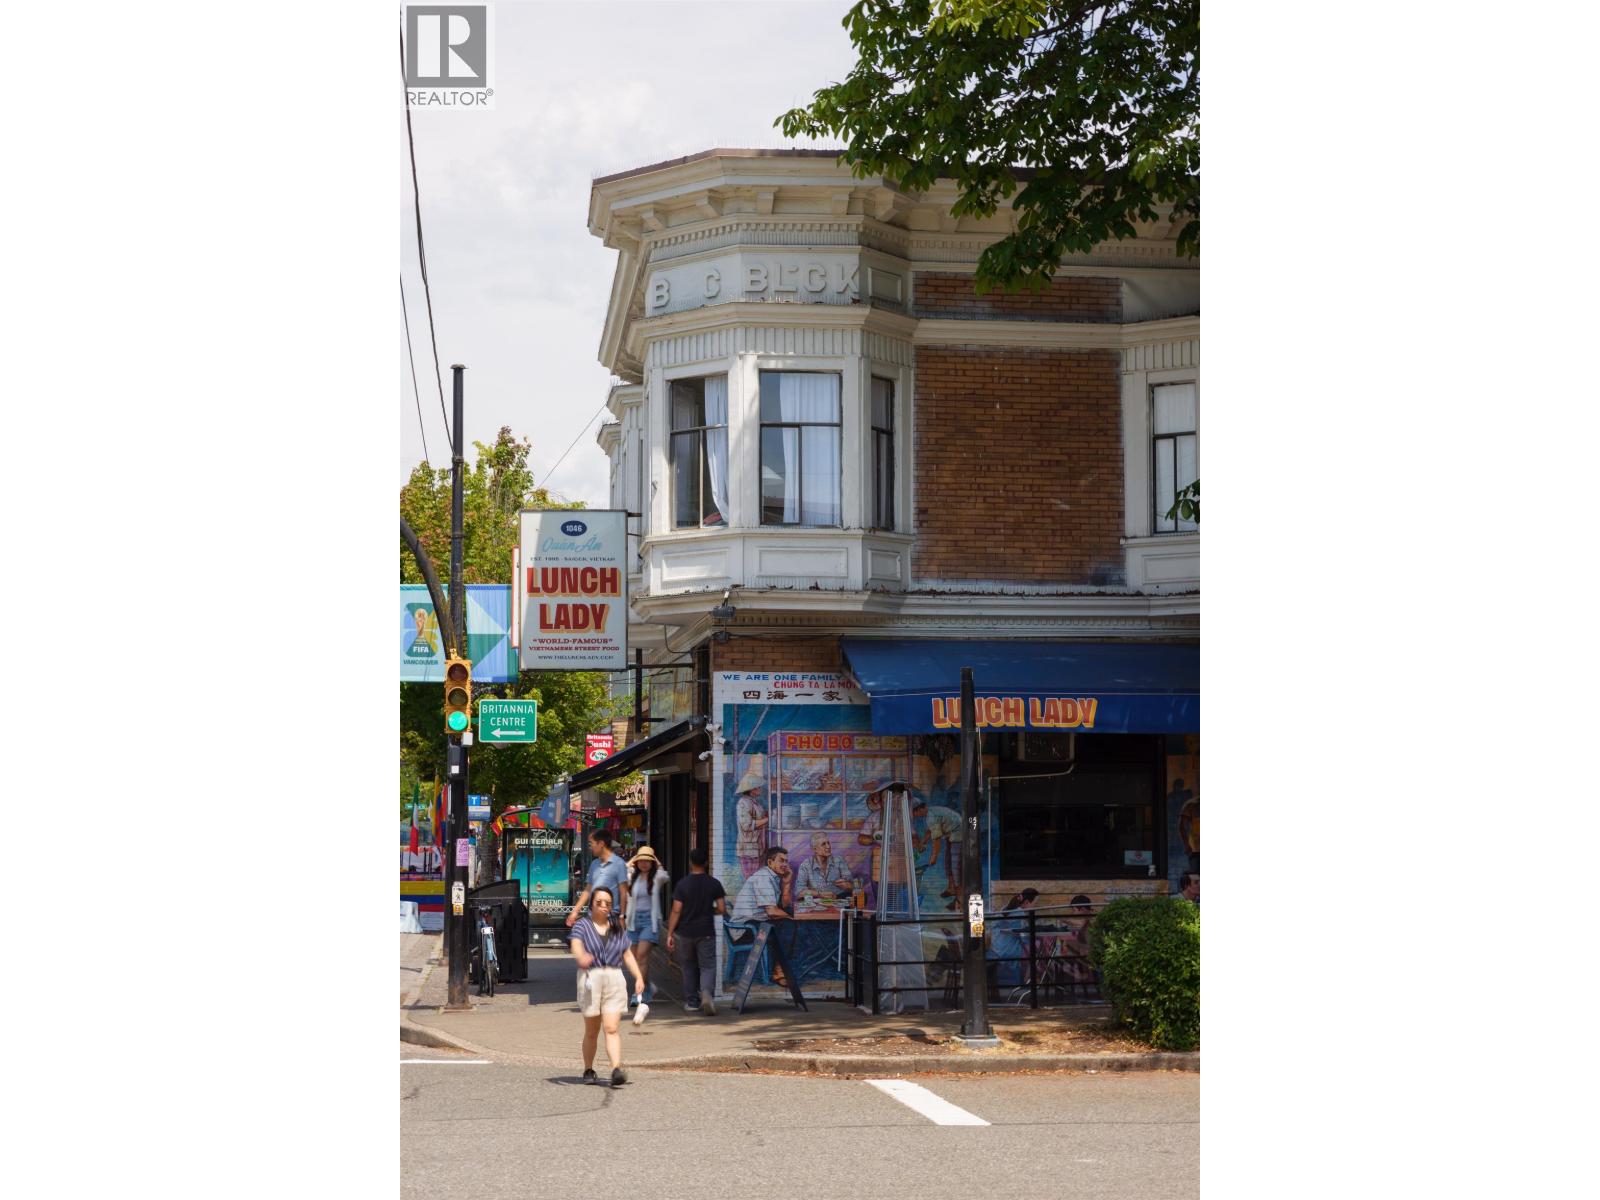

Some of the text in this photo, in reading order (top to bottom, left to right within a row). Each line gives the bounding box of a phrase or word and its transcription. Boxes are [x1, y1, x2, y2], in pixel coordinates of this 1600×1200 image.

[652, 277, 671, 308] B
[566, 524, 583, 533] 1046
[527, 567, 621, 597] LUNCH
[540, 603, 609, 633] LADY
[482, 704, 534, 714] BRITANNIA
[1029, 697, 1098, 728] LADY
[490, 717, 526, 727] CENTRE
[531, 899, 563, 907] WEEKEND
